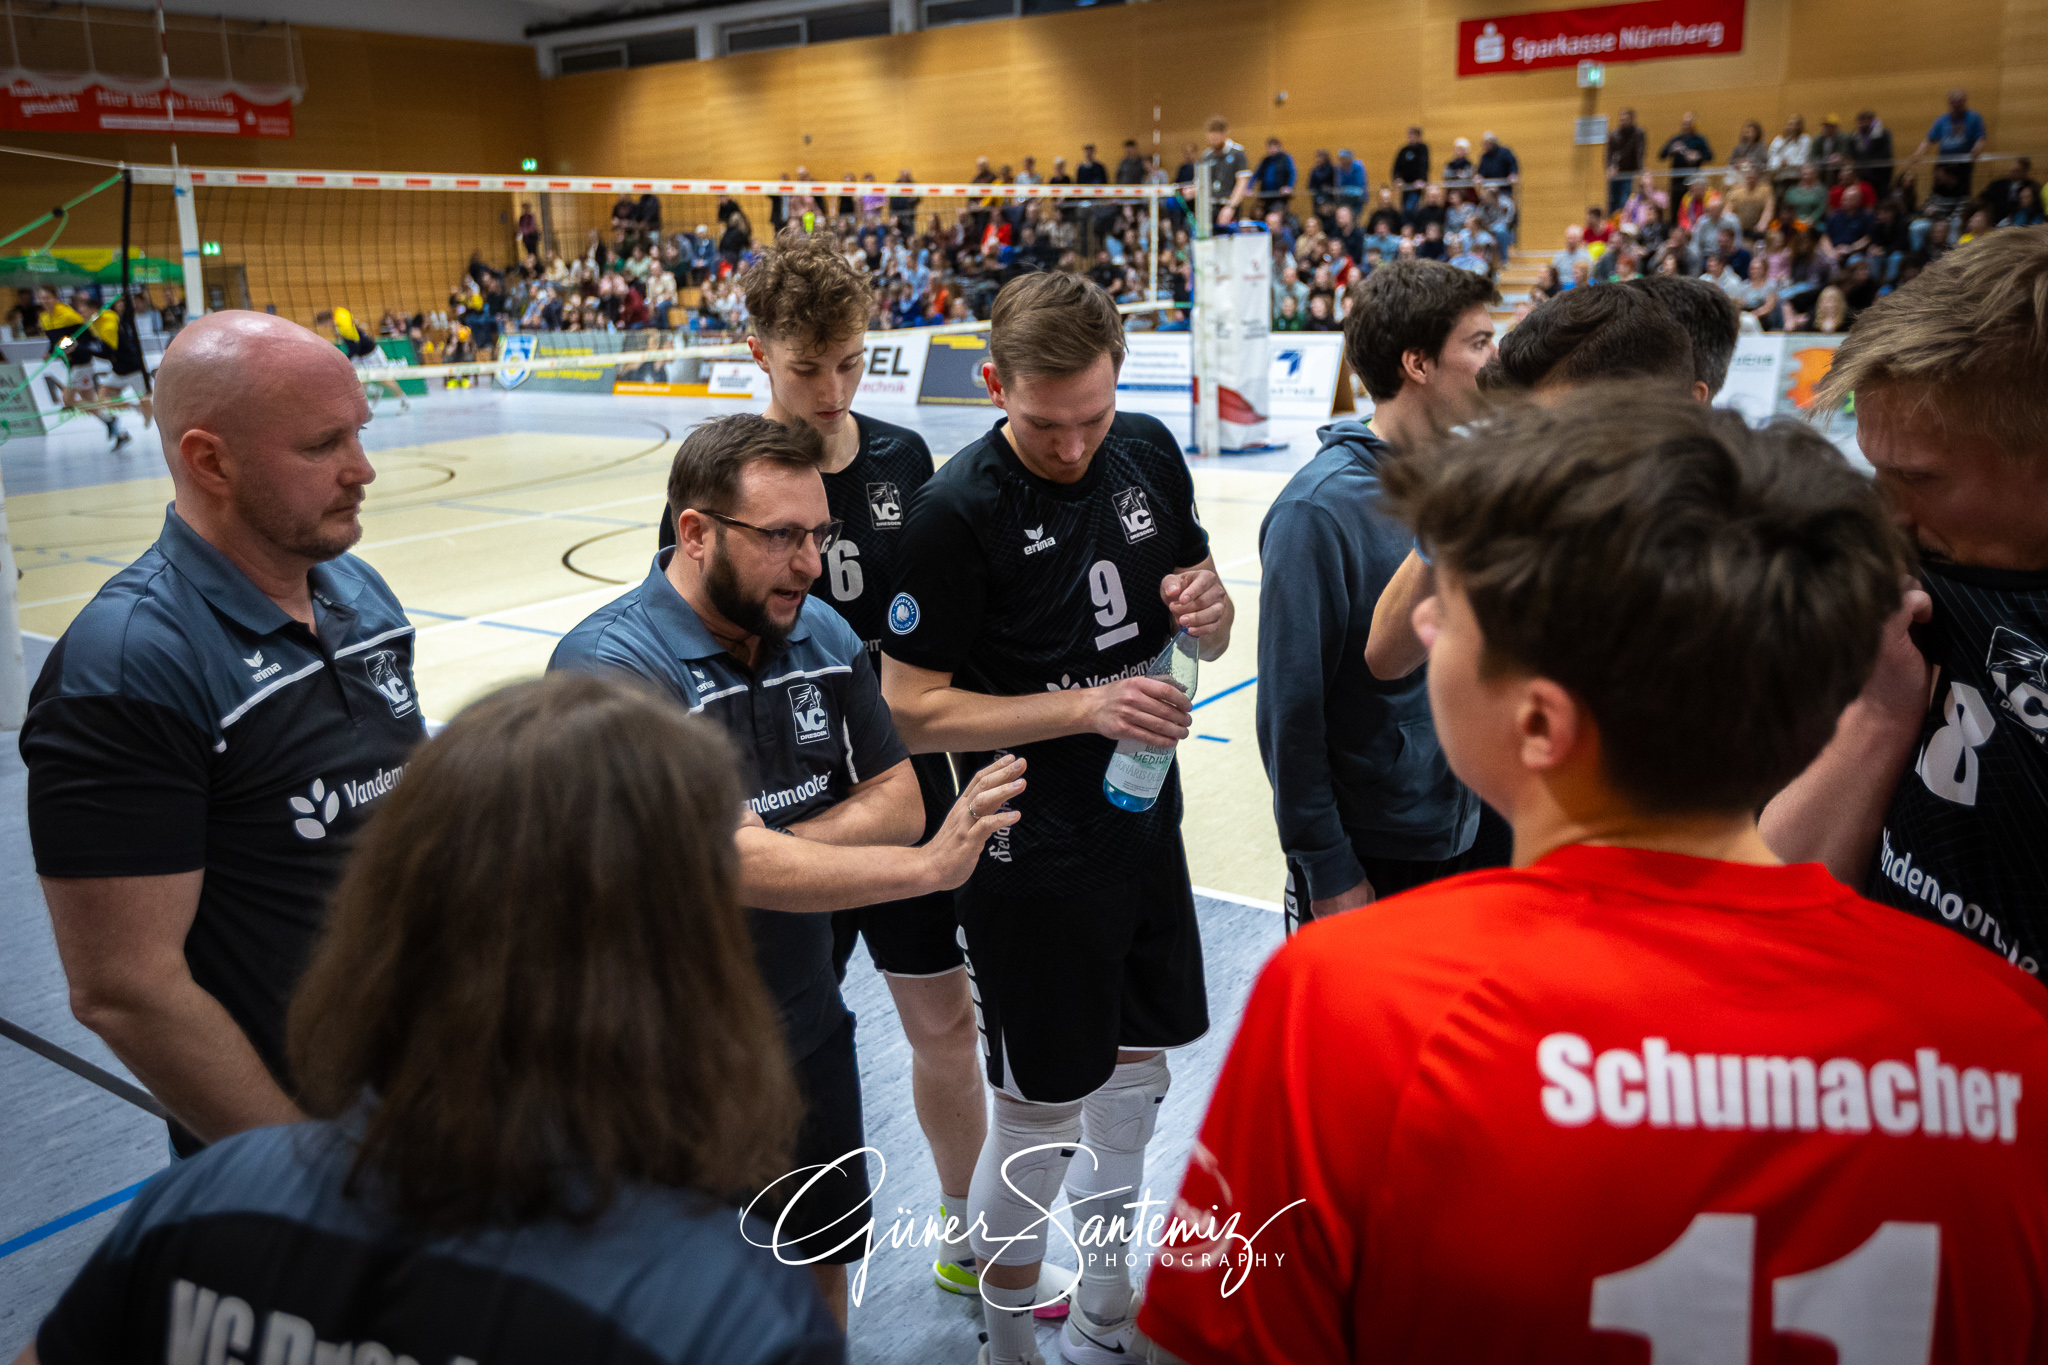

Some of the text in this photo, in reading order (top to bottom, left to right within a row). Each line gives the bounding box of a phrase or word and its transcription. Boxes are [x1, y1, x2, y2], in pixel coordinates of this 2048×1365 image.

[1512, 21, 1725, 64] Sparkasse Nürnberg
[863, 346, 909, 376] EL
[871, 502, 901, 521] VC
[1121, 509, 1152, 533] VC
[1023, 536, 1056, 556] erima
[1129, 527, 1155, 541] DRESDEN
[827, 540, 864, 602] 6
[1089, 560, 1128, 627] 9
[252, 662, 282, 683] erima
[378, 677, 409, 703] VC
[794, 707, 826, 732] VC
[1917, 681, 1996, 806] 8
[1535, 1030, 2022, 1145] Schumacher
[1589, 1211, 1942, 1365] 11
